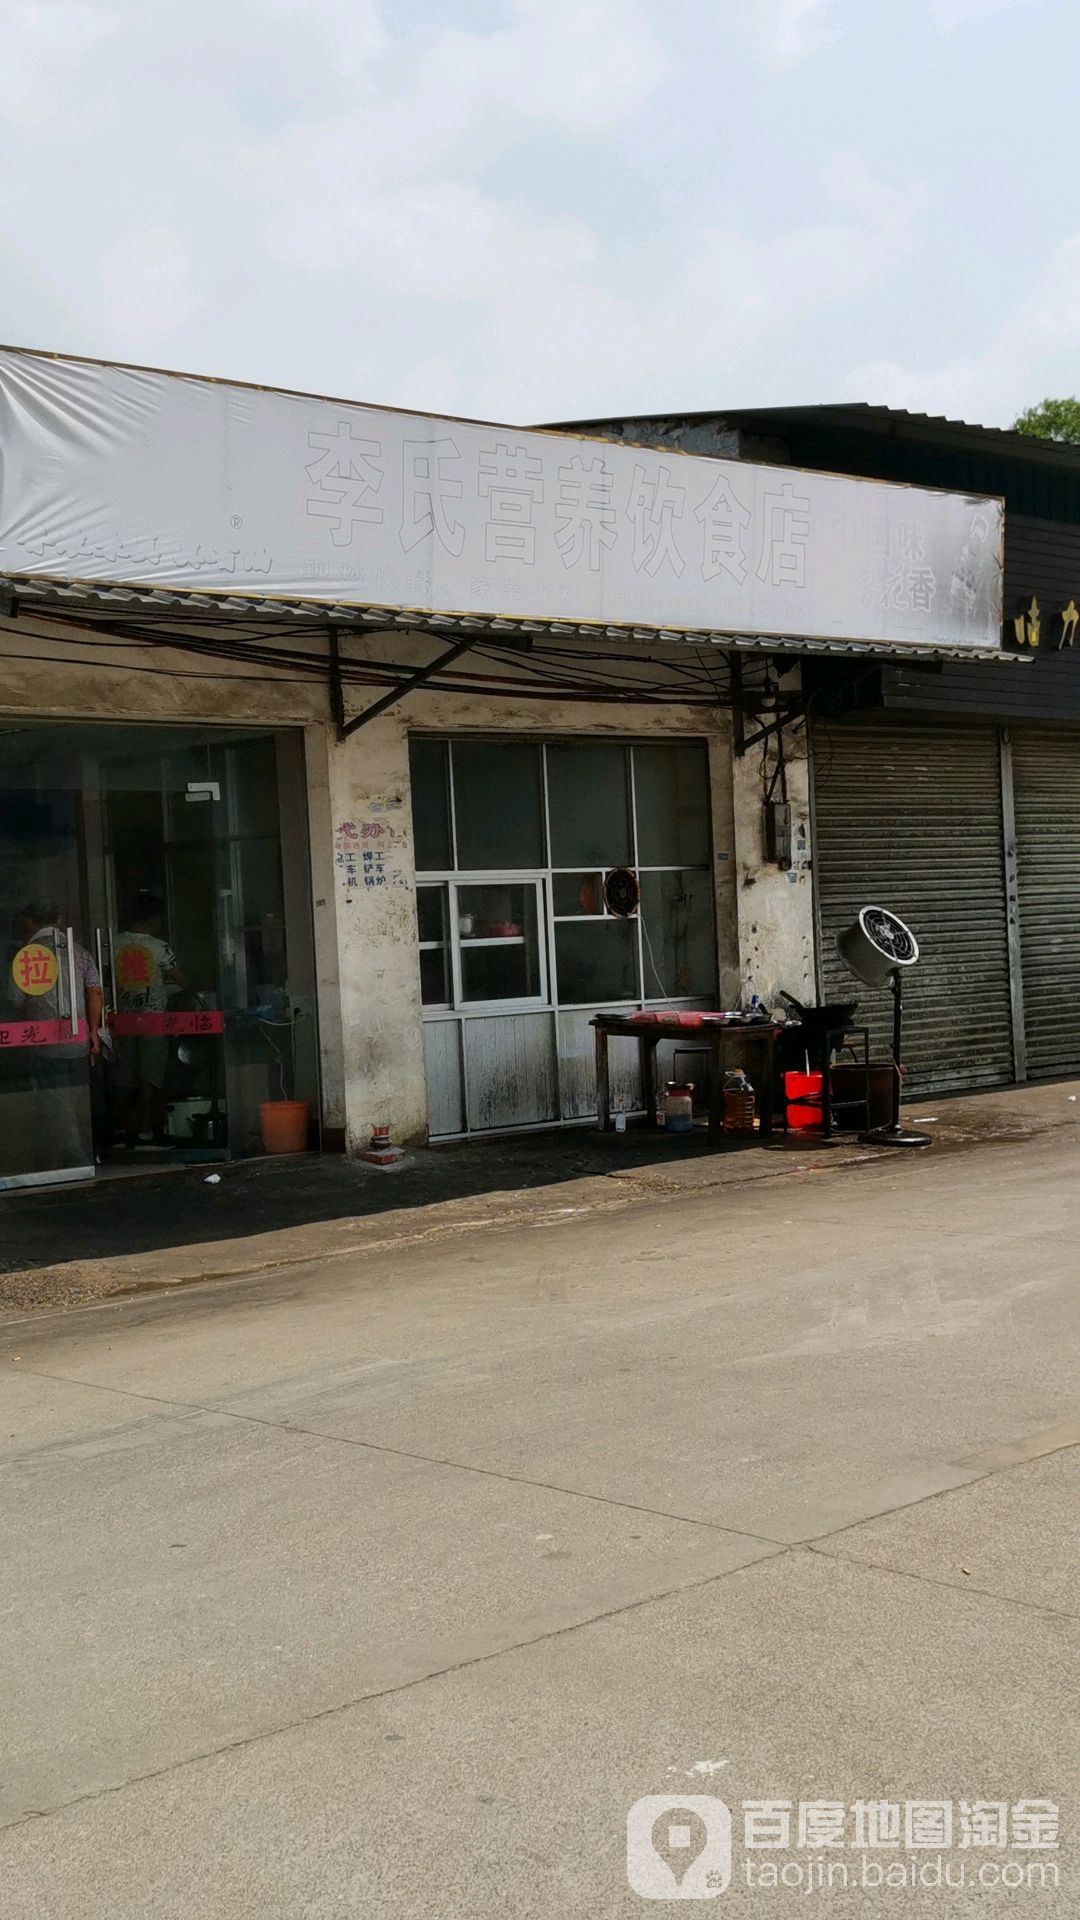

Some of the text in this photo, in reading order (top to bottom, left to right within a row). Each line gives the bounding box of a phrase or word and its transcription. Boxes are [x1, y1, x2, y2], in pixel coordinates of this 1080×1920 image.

[304, 421, 811, 588] 李氏营养饮食店
[20, 950, 52, 987] 拉
